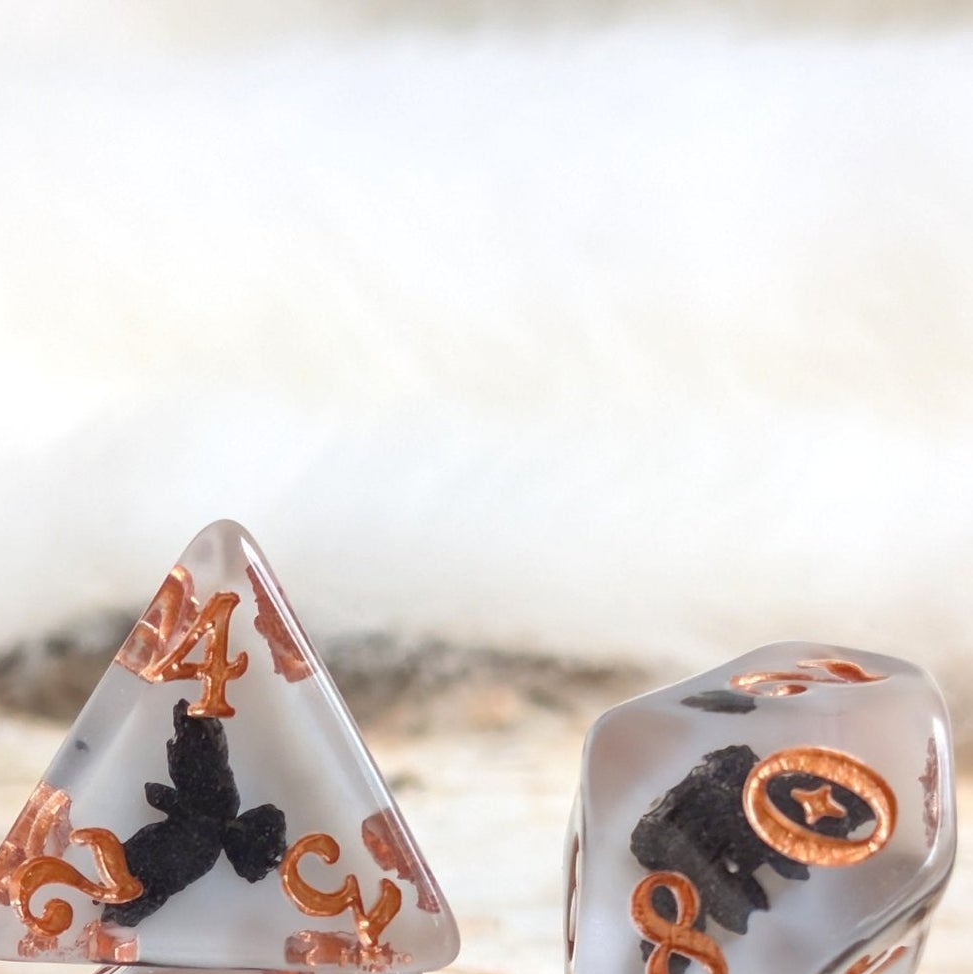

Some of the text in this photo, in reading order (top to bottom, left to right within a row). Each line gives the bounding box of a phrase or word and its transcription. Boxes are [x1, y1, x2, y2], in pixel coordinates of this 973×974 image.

[148, 592, 248, 718] 4
[743, 746, 899, 867] 0
[11, 827, 144, 937] 2
